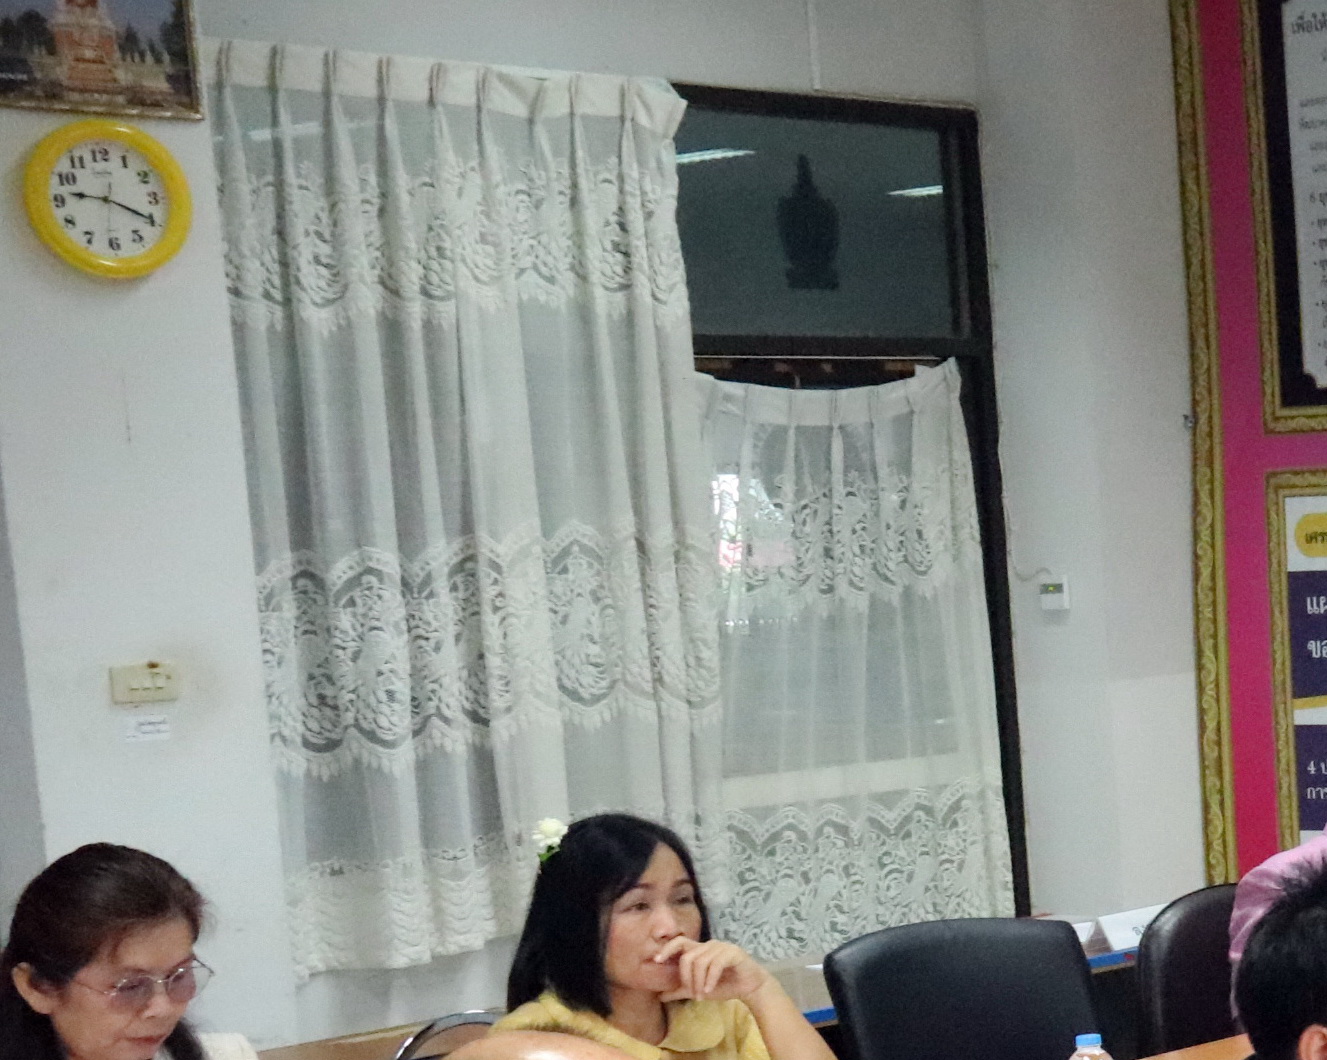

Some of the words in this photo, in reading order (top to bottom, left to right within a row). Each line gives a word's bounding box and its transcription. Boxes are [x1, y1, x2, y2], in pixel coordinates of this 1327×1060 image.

[69, 154, 86, 169] 11
[90, 147, 110, 163] 12
[120, 154, 129, 169] 1
[57, 171, 77, 187] 10
[137, 170, 150, 184] 2
[53, 193, 66, 209] 9
[146, 191, 160, 206] 3
[63, 214, 76, 229] 8
[83, 230, 94, 246] 7
[108, 236, 121, 251] 6
[131, 229, 145, 244] 5
[1307, 761, 1317, 774] 4
